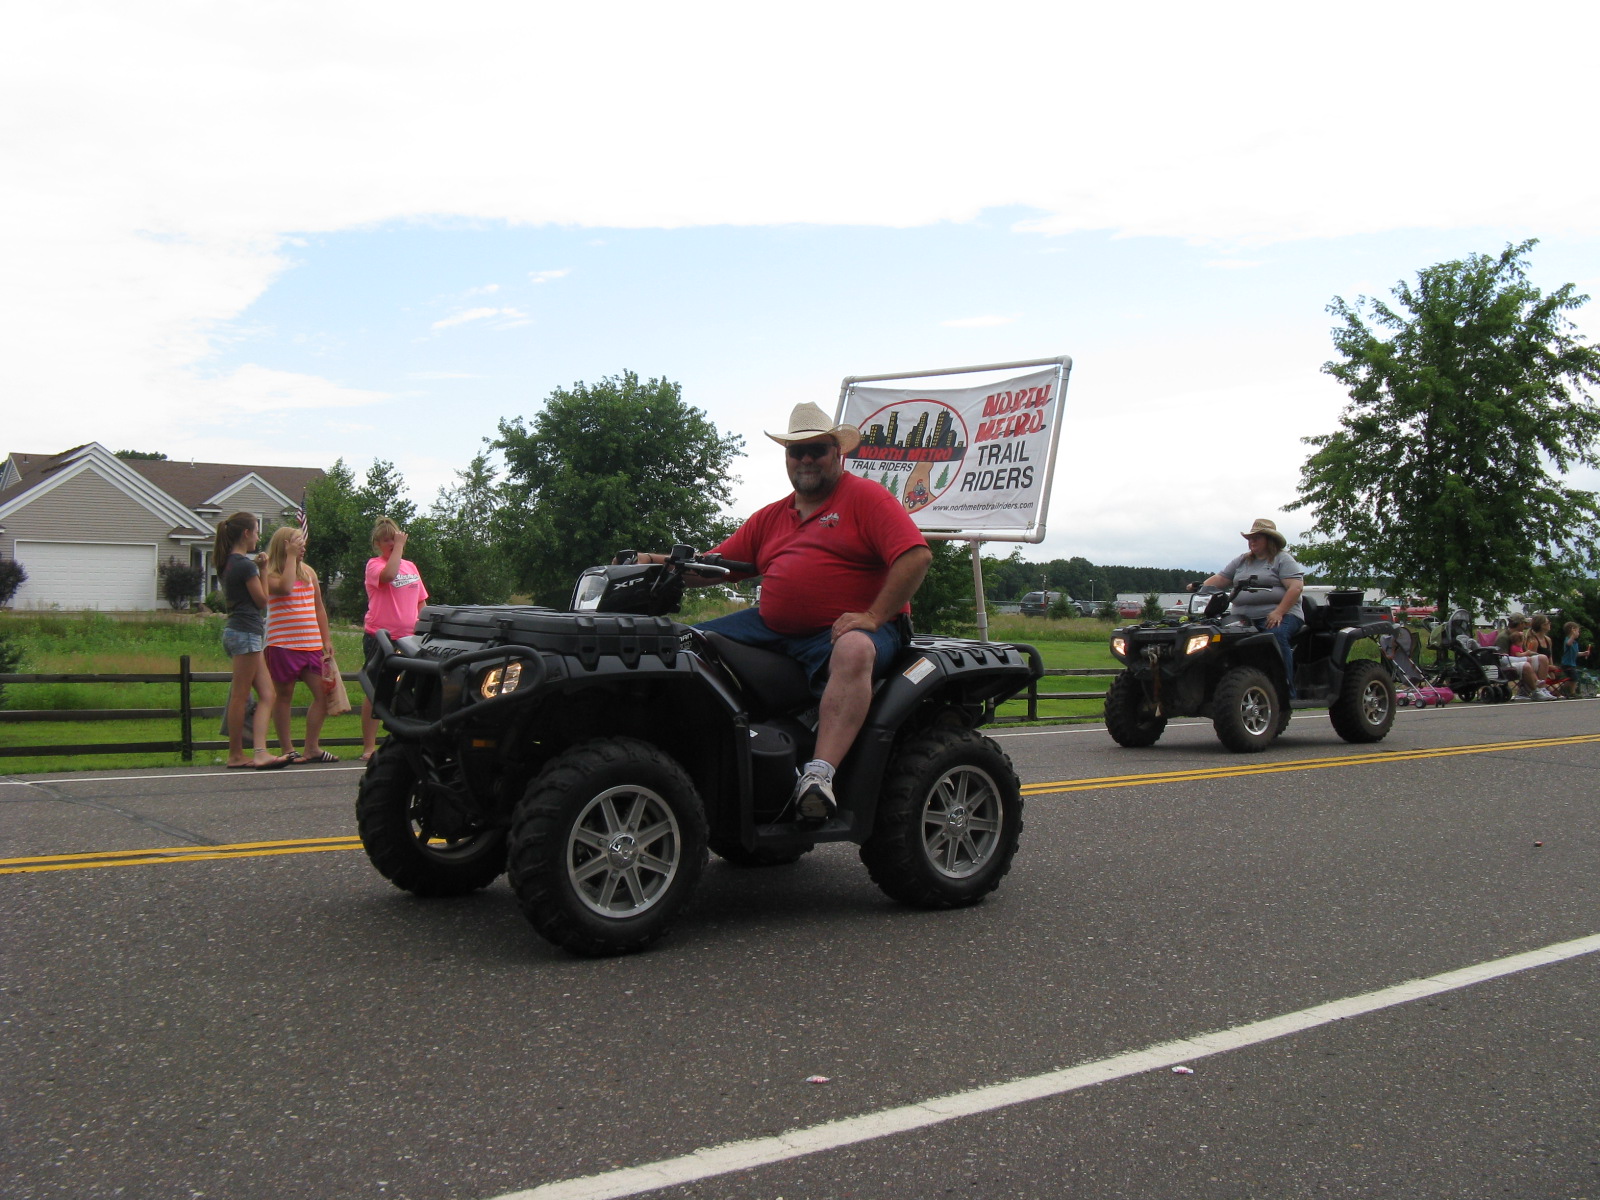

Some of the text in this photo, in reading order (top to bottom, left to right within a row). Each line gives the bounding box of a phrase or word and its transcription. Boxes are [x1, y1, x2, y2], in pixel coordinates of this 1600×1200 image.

[982, 385, 1052, 416] NORTH
[975, 410, 1045, 443] METRO
[858, 446, 952, 461] NORTH METRO
[978, 441, 1030, 466] TRAIL
[851, 461, 914, 472] TRAIL RIDERS
[960, 466, 1034, 492] RIDERS
[932, 501, 1034, 512] www.northmetrotrailriders.com
[613, 577, 645, 591] XP
